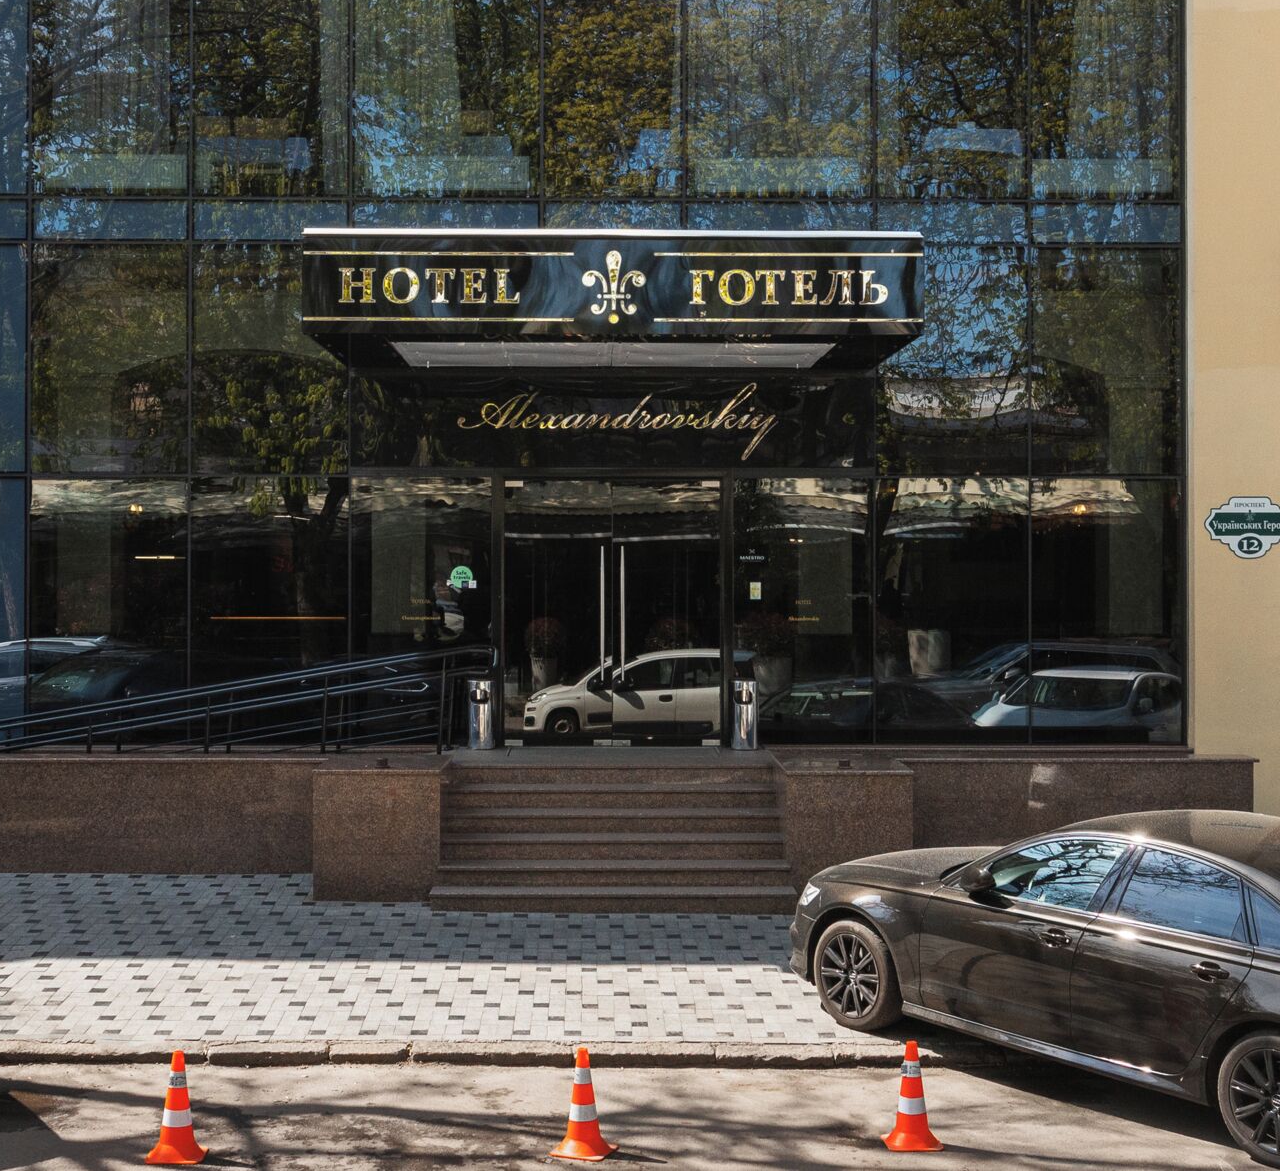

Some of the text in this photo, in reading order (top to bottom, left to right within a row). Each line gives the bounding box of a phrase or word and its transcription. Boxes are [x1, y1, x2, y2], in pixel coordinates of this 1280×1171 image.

[338, 267, 521, 304] HOTEL
[689, 269, 889, 306] ГОТЕЛЬ
[457, 382, 779, 462] Alexandrovskiy
[1212, 520, 1262, 532] Українських
[1241, 539, 1260, 551] 12
